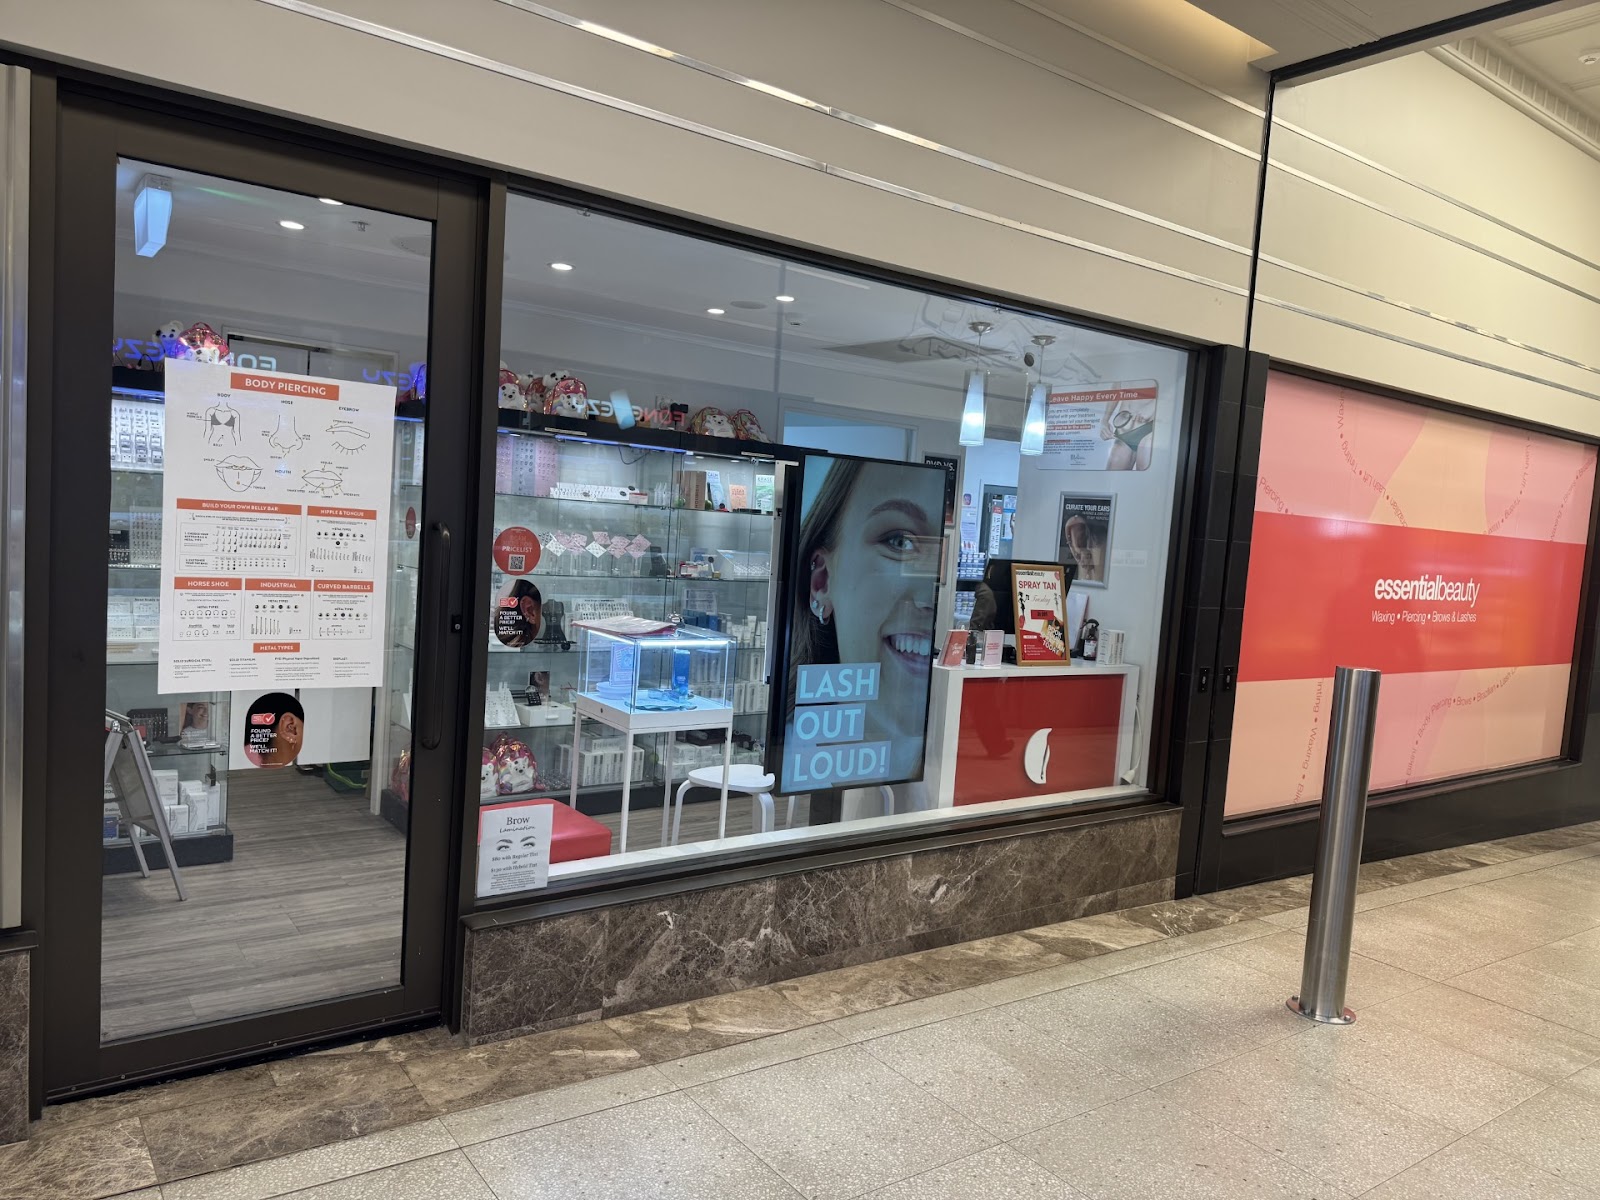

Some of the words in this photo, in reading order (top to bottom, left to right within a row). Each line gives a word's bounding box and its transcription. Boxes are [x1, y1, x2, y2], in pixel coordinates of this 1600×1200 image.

[245, 378, 276, 389] BODY
[277, 381, 327, 395] PIERCING
[1071, 393, 1094, 402] Happy
[1096, 391, 1117, 400] Every
[1120, 390, 1138, 398] Time
[1341, 440, 1357, 475] Tinting
[1258, 476, 1285, 512] Piercing
[1065, 503, 1084, 511] CURATE
[501, 545, 533, 553] PRICELIST
[1018, 580, 1041, 590] SPRAY
[1042, 581, 1057, 590] TAN
[1374, 574, 1481, 608] essentialbeauty
[1371, 610, 1396, 625] Waxing
[1401, 610, 1427, 625] Piercing
[1432, 610, 1451, 622] Brows
[1456, 611, 1477, 622] Lashes
[799, 668, 875, 699] LASH
[1430, 697, 1452, 715] Piercing
[1456, 696, 1473, 707] Brows
[796, 708, 862, 740] OUT
[1302, 727, 1318, 770] Waxing
[793, 746, 887, 782] LOUD!
[499, 825, 536, 833] Lamination
[506, 816, 531, 825] Brow
